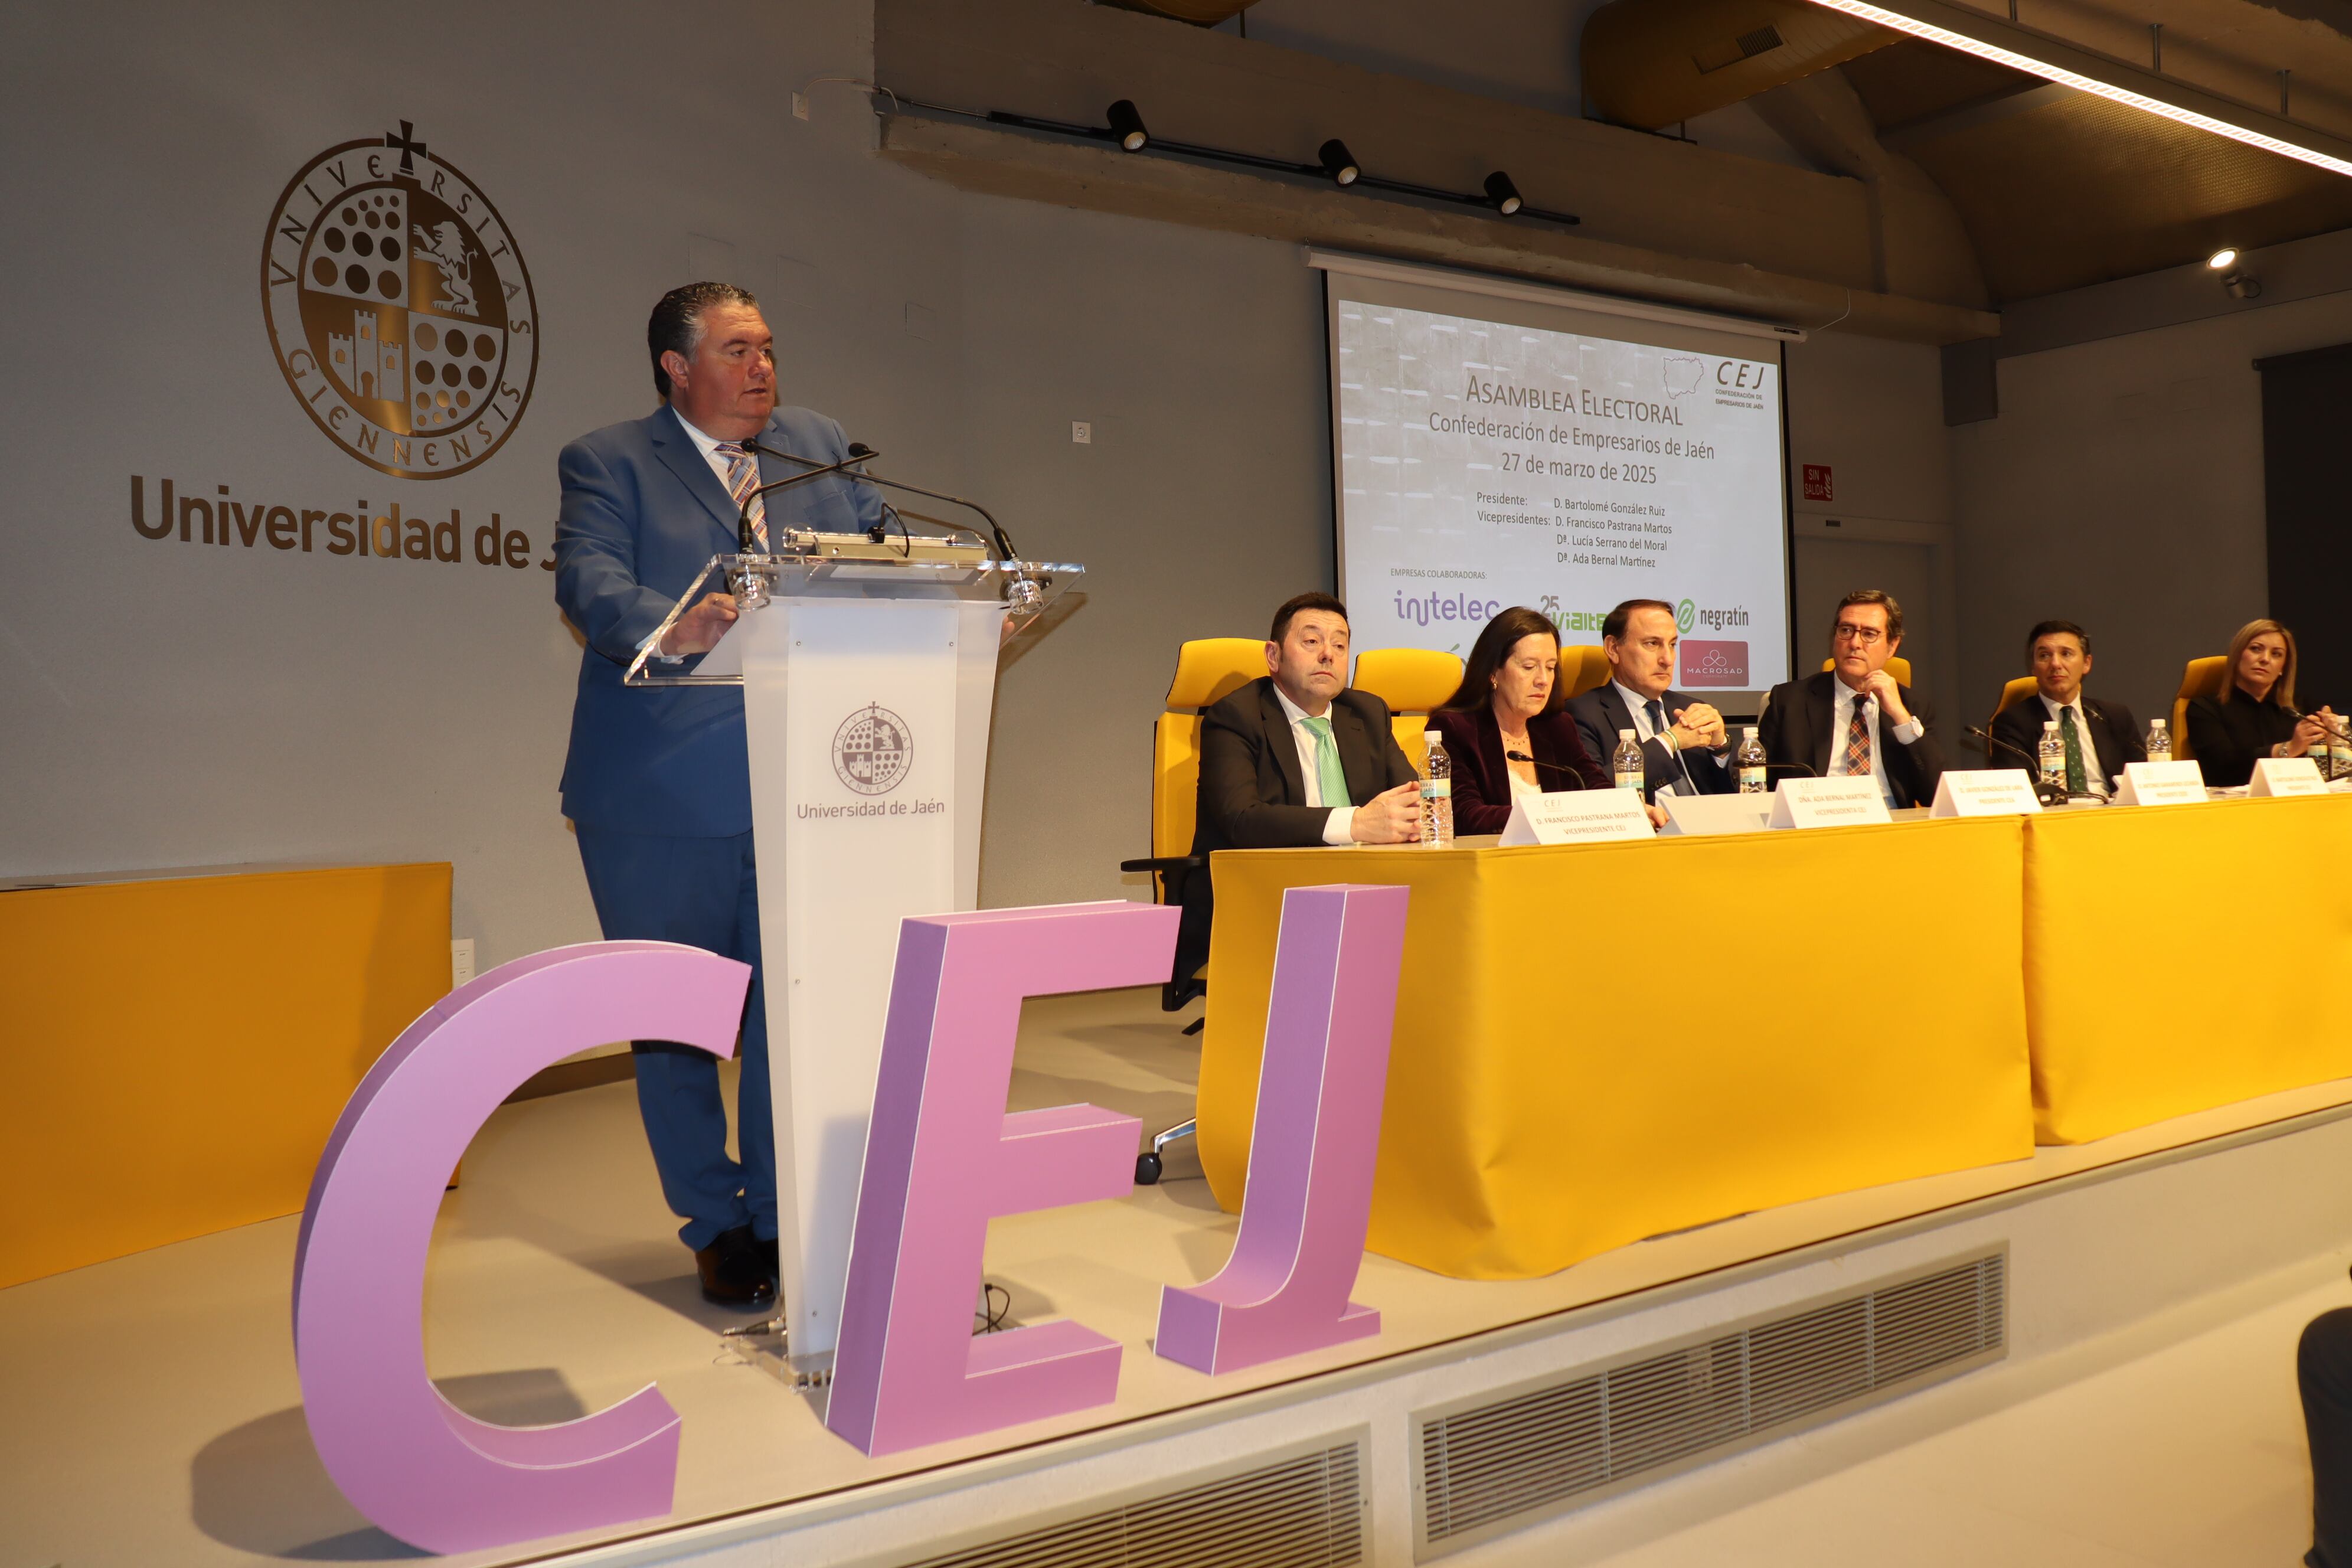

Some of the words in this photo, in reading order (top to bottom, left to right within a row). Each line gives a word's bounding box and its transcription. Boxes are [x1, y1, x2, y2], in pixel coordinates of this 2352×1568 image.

[1466, 375, 1576, 414] ASAMBLEA
[1582, 388, 1683, 426] ELECTORAL
[1716, 388, 1755, 399] CONFEDERACIÓN
[1716, 398, 1746, 407] EMPRESARIOS
[1429, 412, 1544, 442] Confederación
[1549, 424, 1568, 444] de
[1573, 427, 1661, 453] Empresarios
[1665, 437, 1681, 456] de
[1684, 440, 1714, 459] Jaén
[1502, 452, 1520, 471] 27
[1525, 455, 1544, 474] de
[1550, 460, 1595, 479] marzo
[1600, 462, 1618, 481] de
[1622, 463, 1657, 484] 2025
[1808, 469, 1819, 481] SIN
[1805, 483, 1824, 495] SALIDA
[1477, 492, 1528, 506] Presidente:
[1554, 498, 1563, 508] D.
[1565, 499, 1609, 512] Bartolomé
[1611, 502, 1647, 515] González
[1649, 505, 1665, 516] Ruiz
[130, 475, 462, 563] Universidad
[474, 513, 530, 570] de
[1478, 511, 1551, 525] Vicepresidentes:
[1556, 517, 1564, 527] D.
[1567, 517, 1605, 530] Francisco
[1608, 520, 1642, 532] Pastrana
[1644, 523, 1672, 534] Martos
[1572, 535, 1593, 547] Lucía
[1596, 537, 1628, 548] Serrano
[1629, 538, 1642, 550] del
[1644, 540, 1668, 551] Moral
[1573, 553, 1589, 564] Ada
[1592, 554, 1618, 566] Bernal
[1620, 556, 1655, 567] Martínez
[1390, 568, 1426, 577] EMPRESAS
[1427, 569, 1487, 580] COLABORADORAS:
[1700, 605, 1749, 631] negratín
[797, 801, 886, 819] Universidad
[890, 799, 907, 815] de
[910, 798, 945, 814] Jaén
[1544, 815, 1580, 824] FRANCISCO
[1581, 813, 1613, 822] PASTRANA
[1614, 811, 1641, 819] MARTOS
[1563, 825, 1615, 835] VICEPRESIDENTE
[293, 883, 1410, 1556] CEJ
